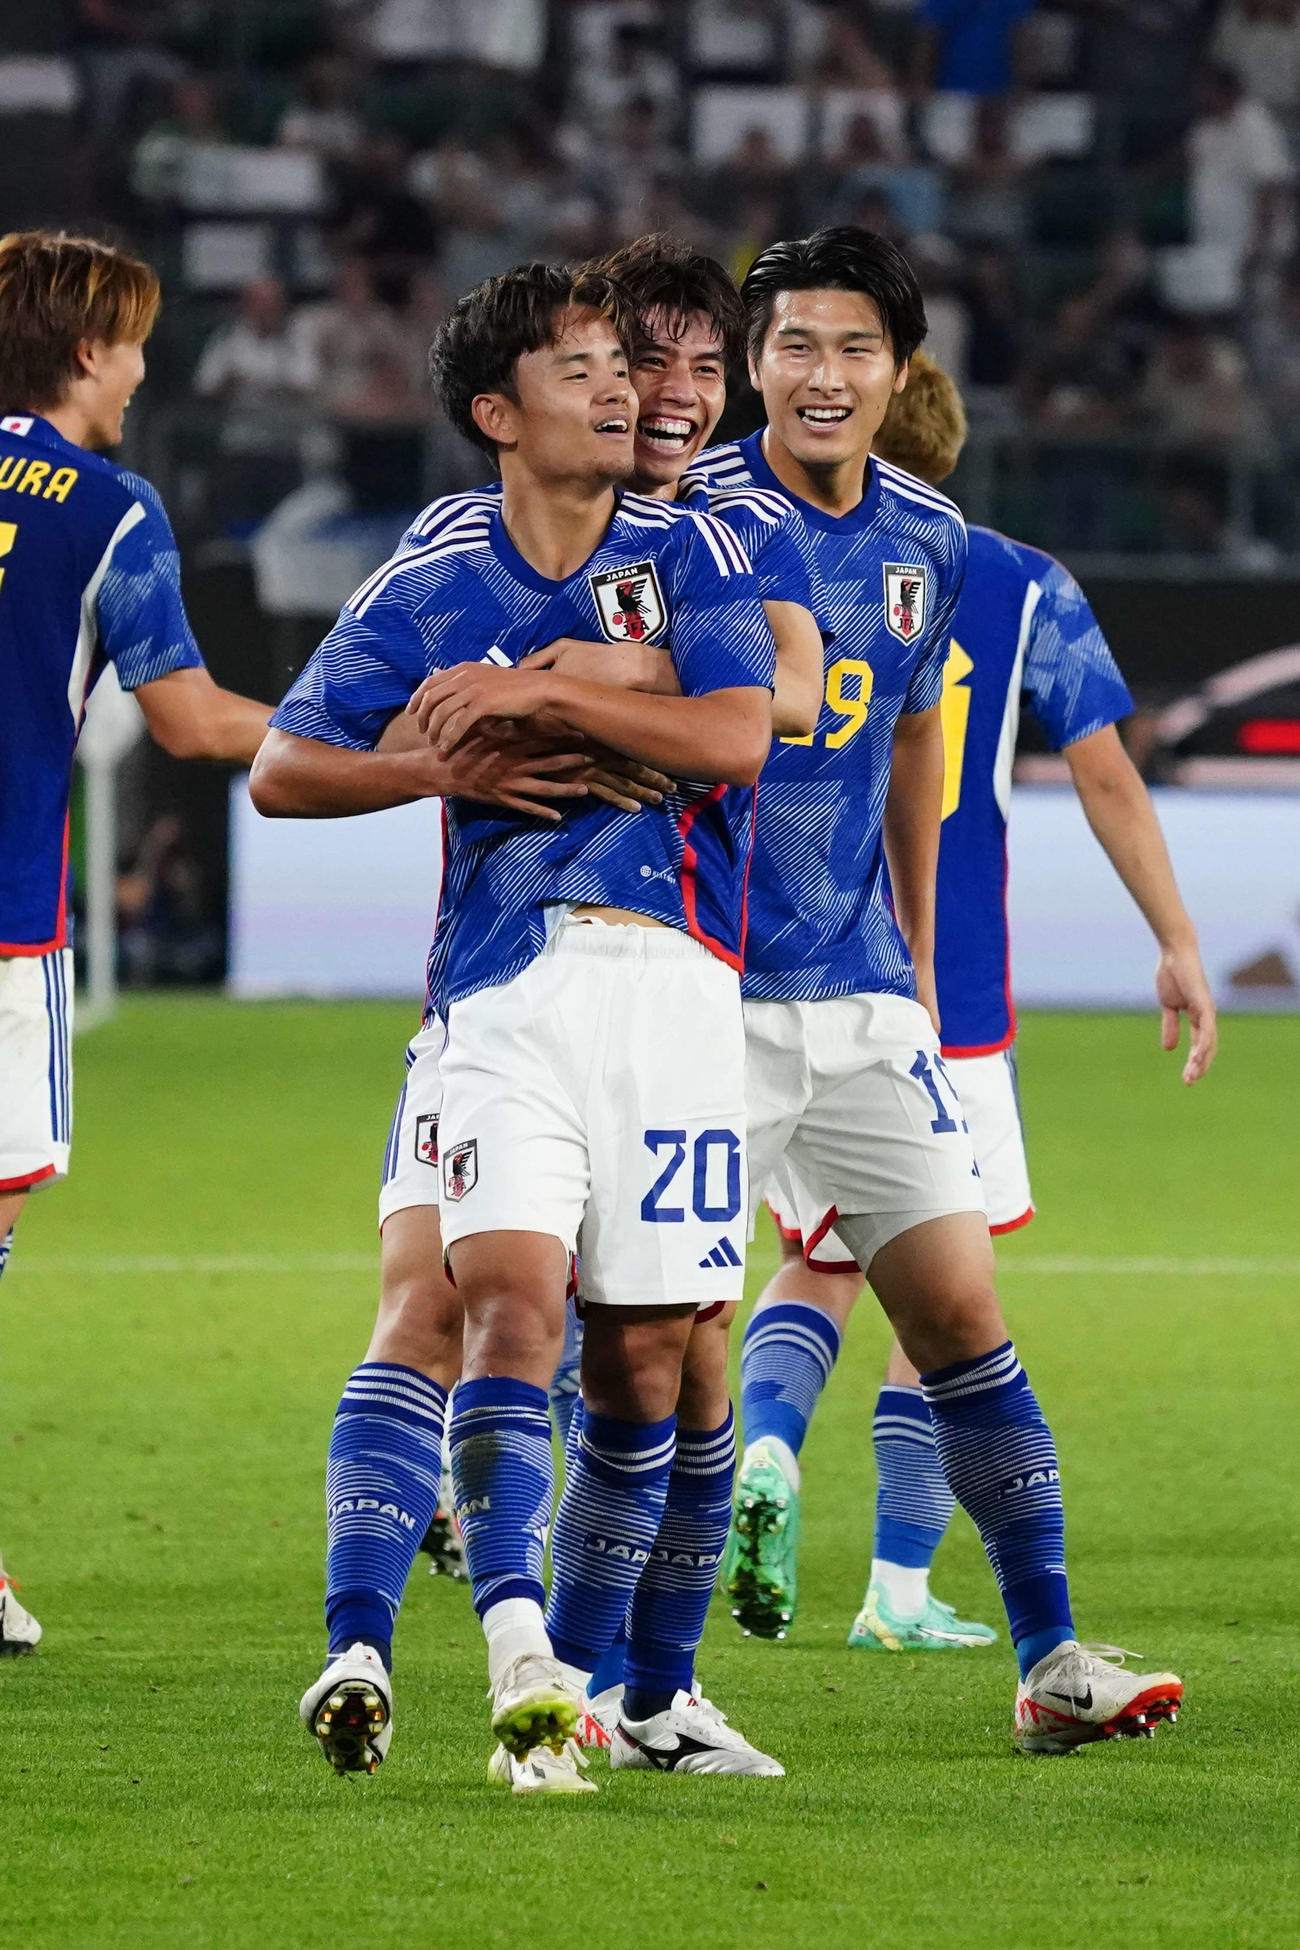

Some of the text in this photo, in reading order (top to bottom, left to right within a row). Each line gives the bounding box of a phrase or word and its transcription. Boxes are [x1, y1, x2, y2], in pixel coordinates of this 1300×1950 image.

[606, 567, 638, 582] JAPAN
[895, 566, 917, 575] JAPAN
[779, 659, 874, 750] 9
[640, 1129, 743, 1223] 20
[329, 1498, 416, 1530] JAPAN
[586, 1538, 651, 1565] JAP
[650, 1549, 725, 1567] JAP
